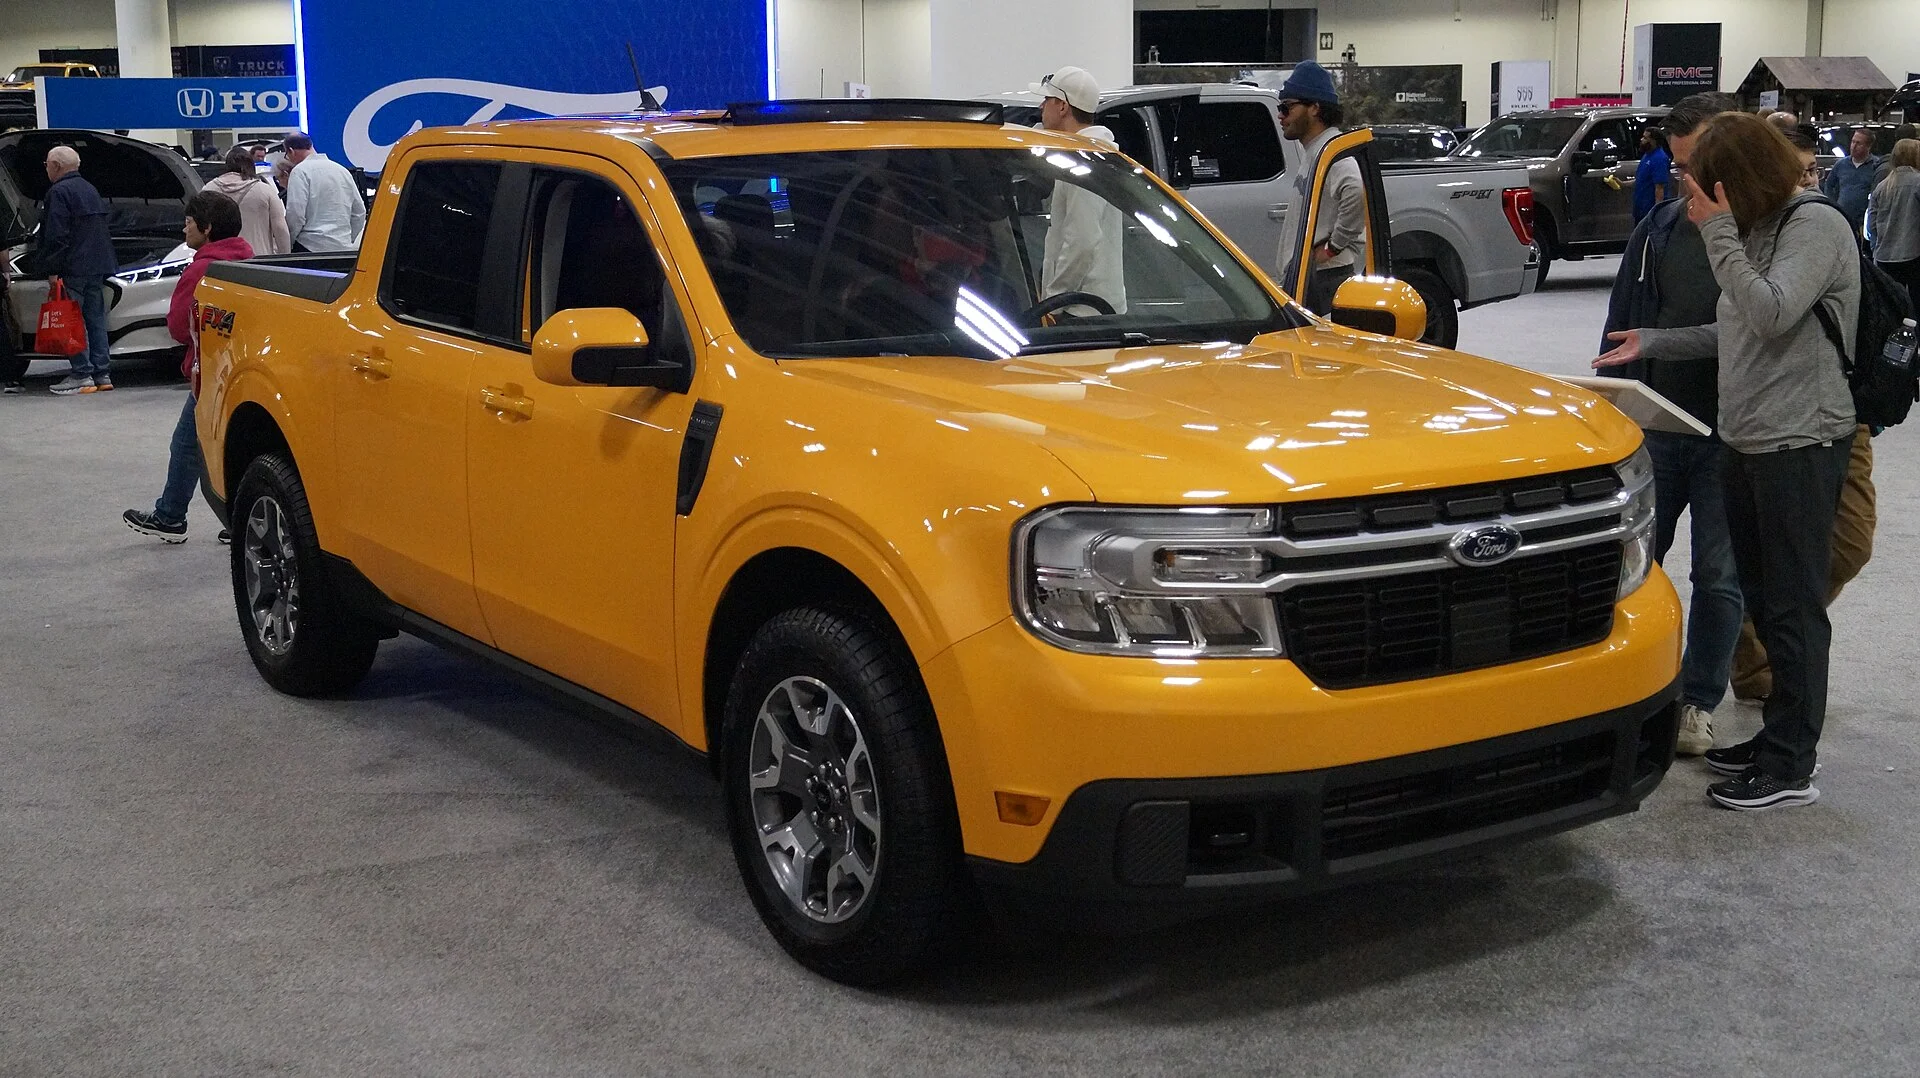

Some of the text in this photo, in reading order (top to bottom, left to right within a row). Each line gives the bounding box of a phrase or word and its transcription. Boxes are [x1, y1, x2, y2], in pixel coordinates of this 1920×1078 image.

[238, 61, 285, 71] TRUCK
[1657, 67, 1713, 78] GMC
[1450, 189, 1494, 199] SPORT
[201, 305, 235, 333] FX4
[1473, 536, 1508, 557] Ford
